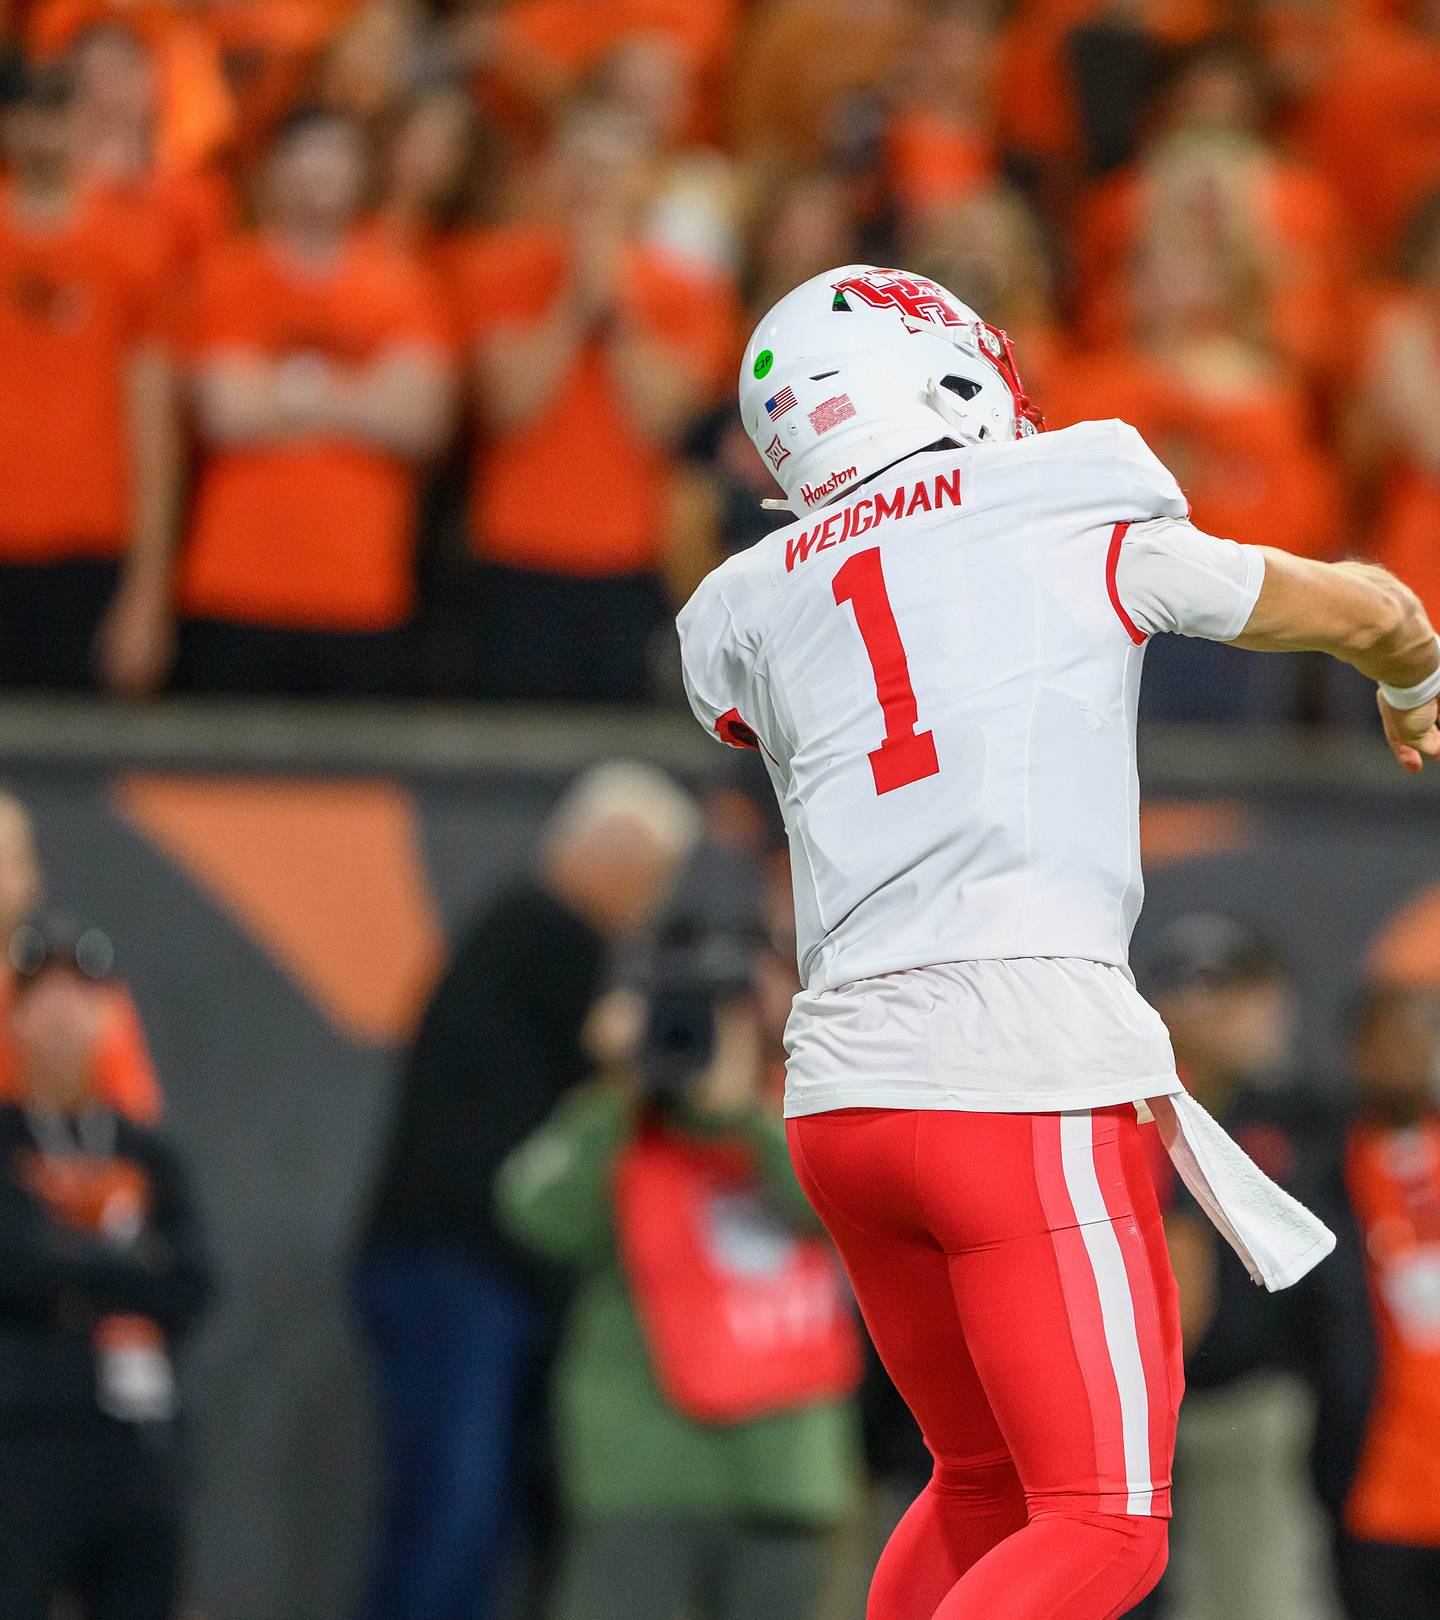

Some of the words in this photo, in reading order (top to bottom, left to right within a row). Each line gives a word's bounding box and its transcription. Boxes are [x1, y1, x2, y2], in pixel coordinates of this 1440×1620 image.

[754, 355, 771, 373] C2P
[785, 468, 962, 573] WEIGMAN
[800, 466, 857, 507] Houston
[831, 546, 940, 796] 1
